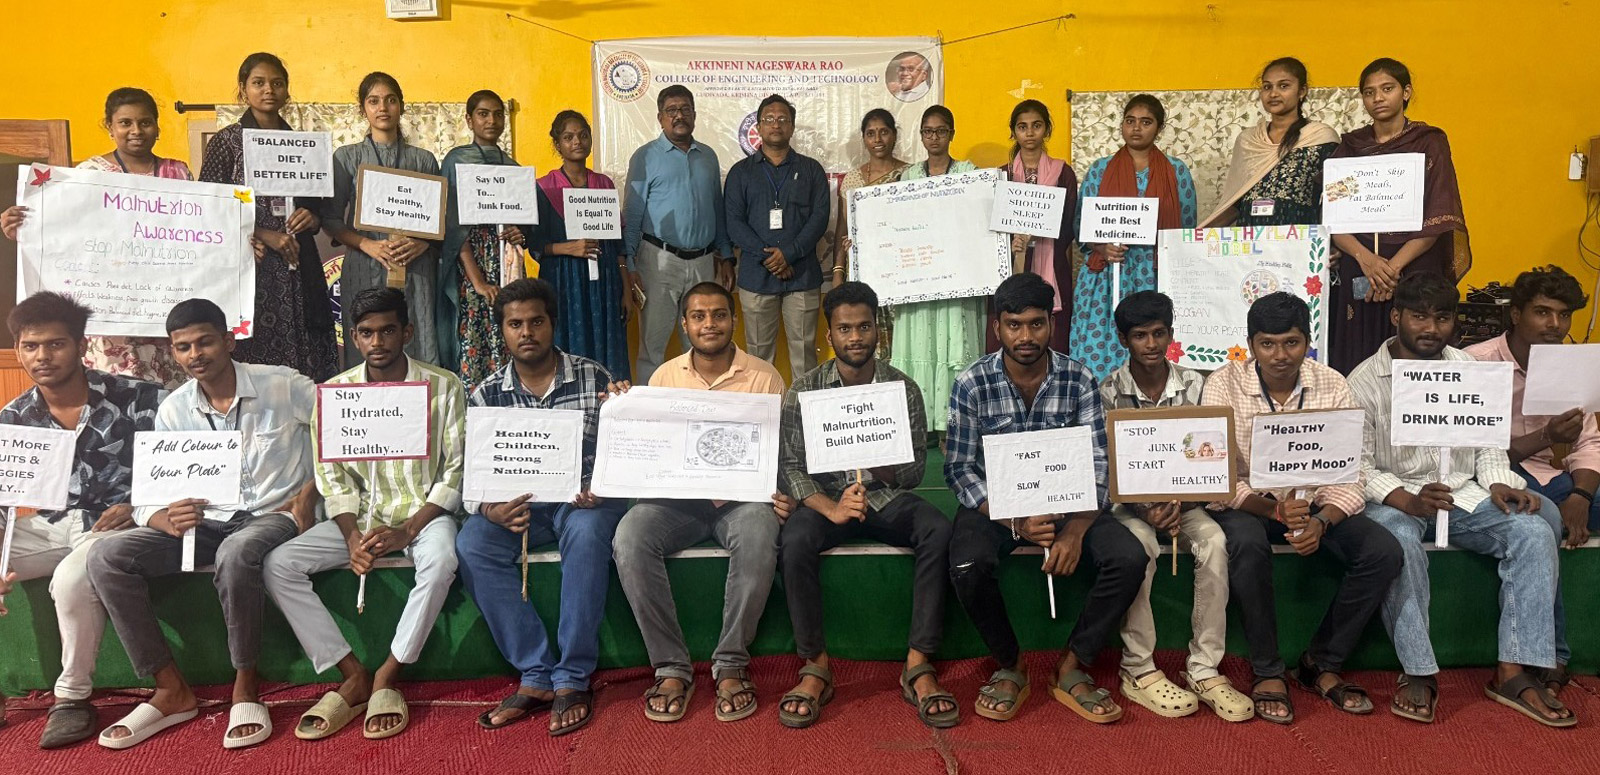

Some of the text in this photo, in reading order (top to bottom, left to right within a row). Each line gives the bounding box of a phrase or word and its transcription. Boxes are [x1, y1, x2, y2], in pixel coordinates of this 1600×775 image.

[687, 60, 844, 71] AKKINENI NAGESWARA RAO
[655, 74, 880, 85] COLLEGE OF ENGINEERING AND TECHNOLOGY
[252, 137, 316, 148] “BALANCED
[278, 155, 306, 165] DIET,
[253, 170, 328, 181] BETTER LIFE”
[1387, 168, 1405, 178] Skip
[475, 175, 505, 184] Say NO
[397, 185, 412, 194] Eat
[477, 188, 495, 197] To...
[1008, 188, 1056, 200] NO CHILD
[388, 195, 423, 208] Healthy,
[569, 195, 617, 204] Good Nutrition
[1365, 192, 1405, 202] Balanced
[477, 202, 497, 211] Junk
[1009, 199, 1050, 210] SHOULD
[1095, 203, 1150, 211] Nutrition is
[375, 206, 431, 221] Stay Healthy
[577, 209, 613, 219] Is Equal To
[1013, 210, 1044, 219] SLEEP
[1102, 216, 1141, 225] the Best
[133, 221, 224, 244] Awareness
[583, 223, 600, 231] Good
[1094, 230, 1146, 239] Medicine...
[1183, 225, 1318, 242] HEALTHY PLATE
[1403, 371, 1461, 382] “WATER
[335, 389, 362, 402] Stay
[1425, 393, 1484, 406] IS LIFE,
[341, 406, 404, 420] Hydrated,
[823, 416, 896, 433] Malnurtrition,
[1402, 413, 1503, 426] DRINK MORE”
[341, 426, 368, 439] Stay
[495, 430, 551, 440] Healthy
[826, 430, 897, 448] Build Nation”
[12, 439, 52, 451] MORE
[152, 439, 177, 455] Add
[181, 440, 224, 456] Colour
[227, 438, 239, 450] to
[342, 443, 404, 456] Healthy...
[494, 442, 560, 451] Children,
[29, 455, 40, 465] &
[493, 454, 542, 465] Strong
[1128, 460, 1166, 470] START
[150, 465, 183, 480] Your
[1045, 463, 1067, 474] FOOD
[1017, 479, 1041, 491] SLOW
